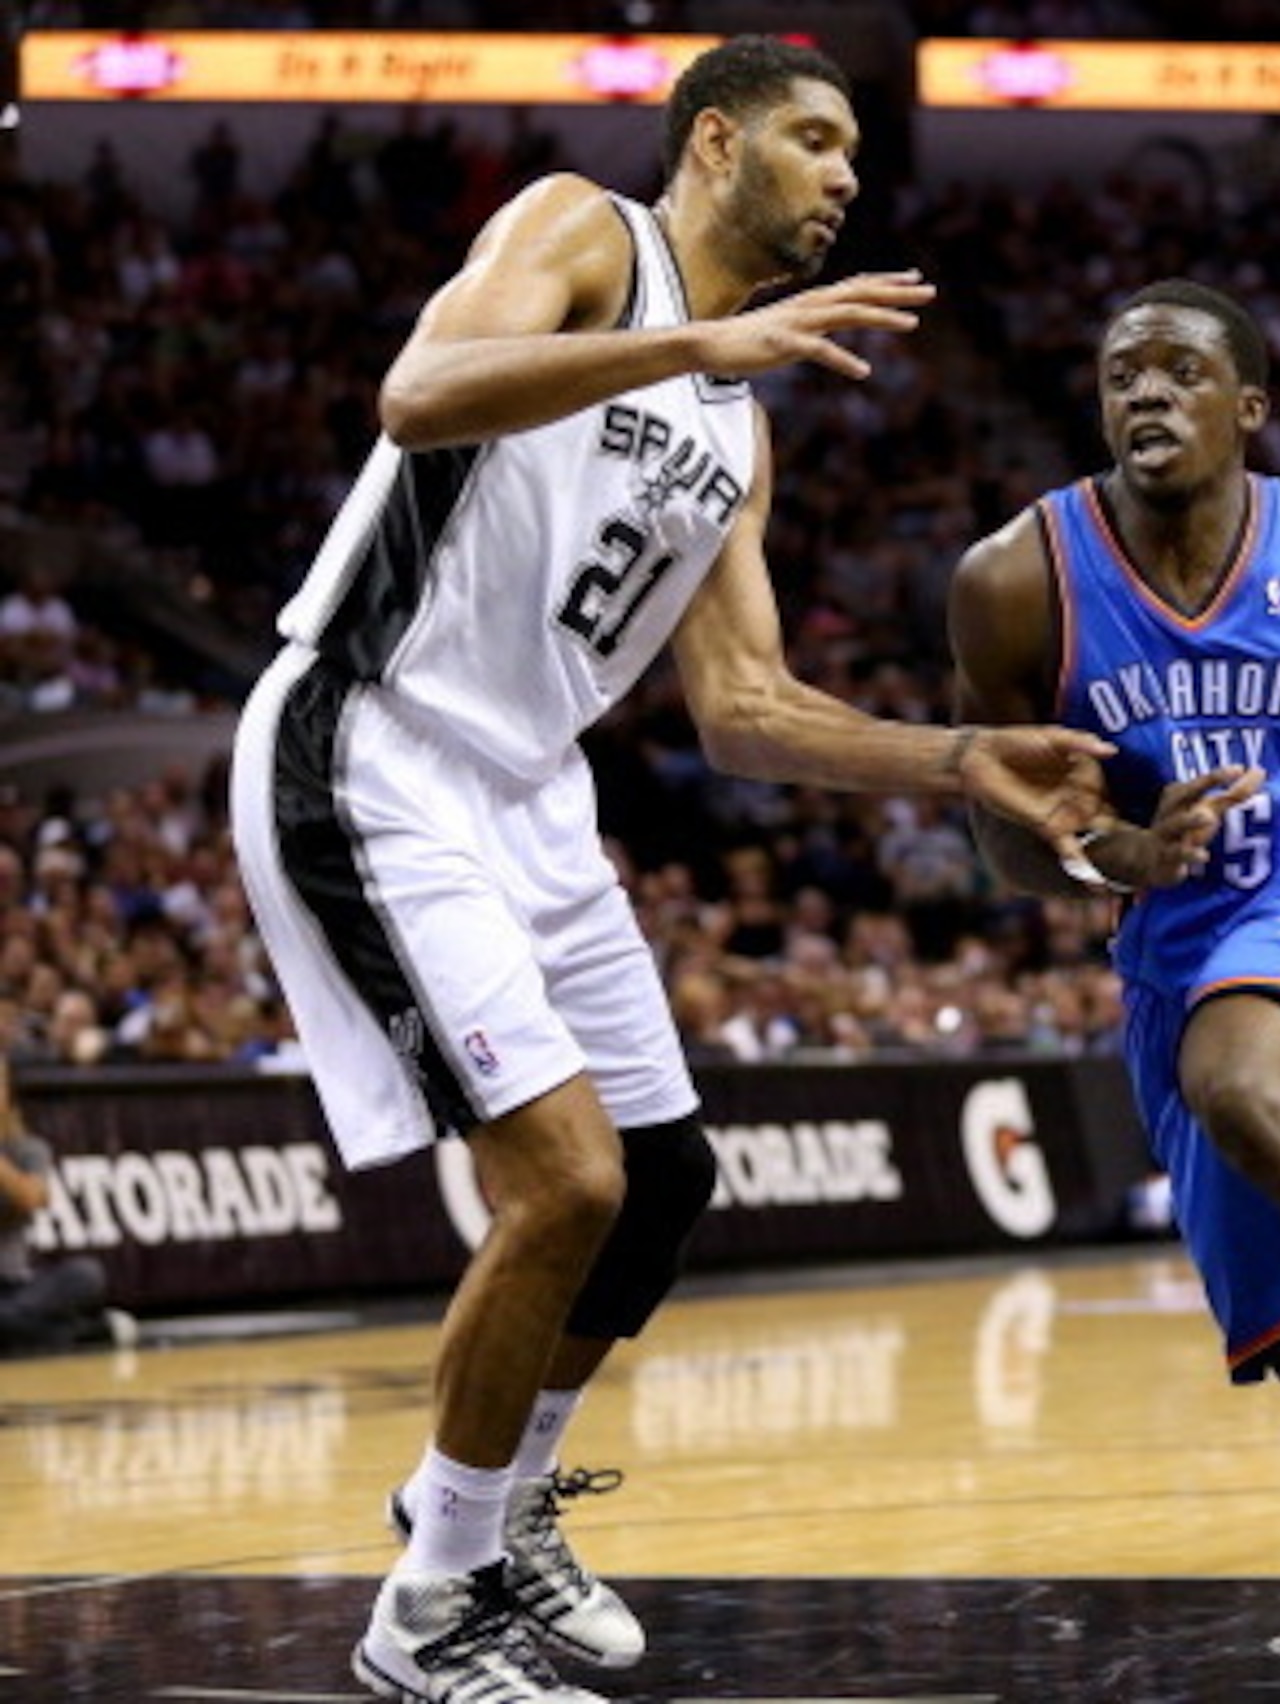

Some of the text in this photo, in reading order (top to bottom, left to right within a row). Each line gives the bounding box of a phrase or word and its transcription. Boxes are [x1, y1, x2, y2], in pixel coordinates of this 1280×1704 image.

[600, 402, 743, 525] SPUR
[554, 516, 678, 658] 21
[1170, 728, 1266, 785] CITY
[1188, 794, 1273, 889] 5
[24, 1142, 343, 1250] ATORADE
[702, 1120, 901, 1211] TORADE
